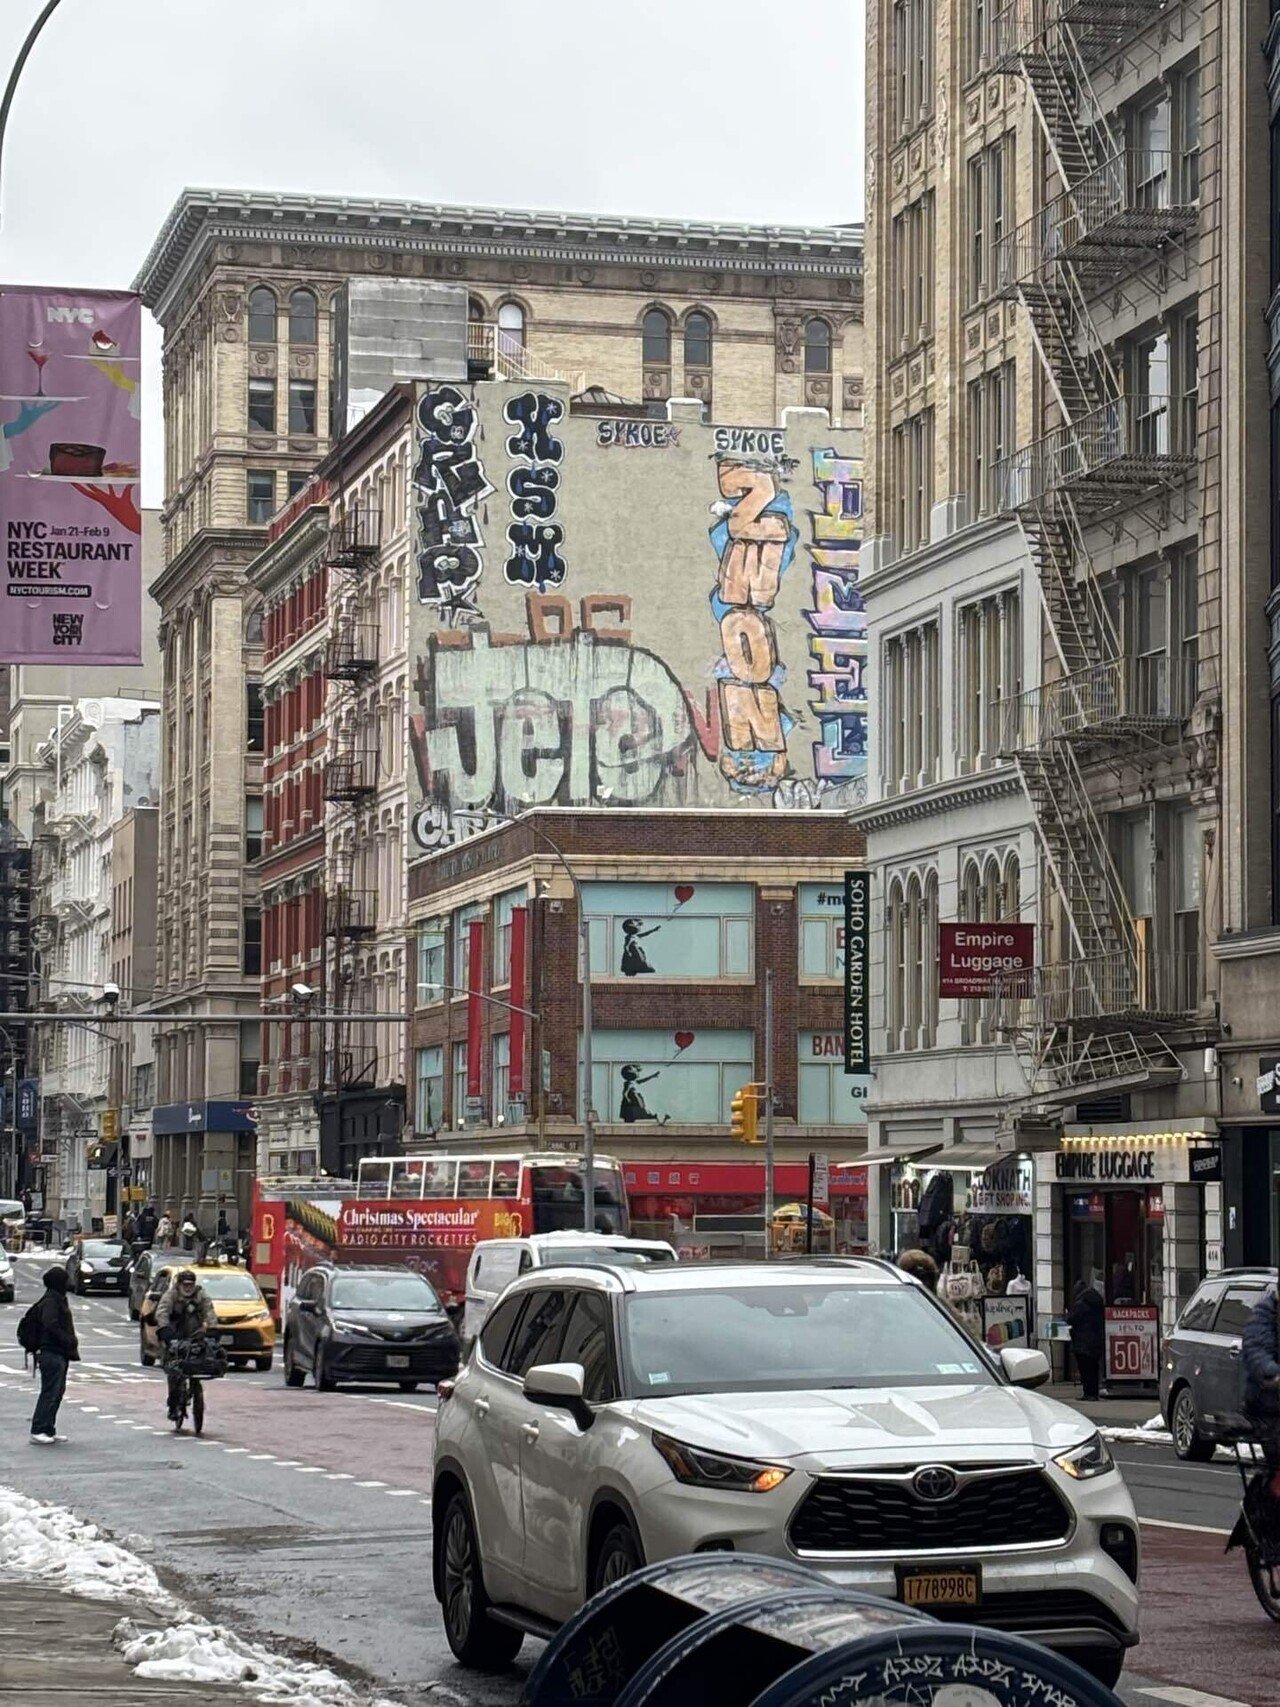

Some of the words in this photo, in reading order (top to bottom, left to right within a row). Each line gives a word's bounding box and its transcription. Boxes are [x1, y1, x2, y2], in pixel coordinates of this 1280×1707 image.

[47, 306, 95, 323] NYC
[597, 420, 667, 449] SYKOE
[713, 428, 785, 455] SYKOE
[7, 521, 47, 539] NYC
[50, 526, 67, 536] Jan
[7, 541, 133, 560] RESTAURANT
[7, 560, 62, 579] WEEK
[9, 585, 88, 595] NYCTOURISM.COM
[850, 878, 865, 931] SOHO
[955, 931, 1014, 950] Empire
[850, 935, 865, 1008] GARDEN
[951, 953, 1023, 971] Luggage
[850, 1012, 865, 1067] HOTEL
[1055, 1151, 1097, 1179] EMPIRE
[1099, 1150, 1155, 1179] LUGGAGE
[343, 1208, 403, 1225] Christmas
[342, 1233, 378, 1246] RADIO
[381, 1233, 407, 1246] CITY
[410, 1233, 478, 1246] ROCKETTES
[1112, 1309, 1150, 1319] BACKPACKS
[906, 1577, 973, 1601] T778998C
